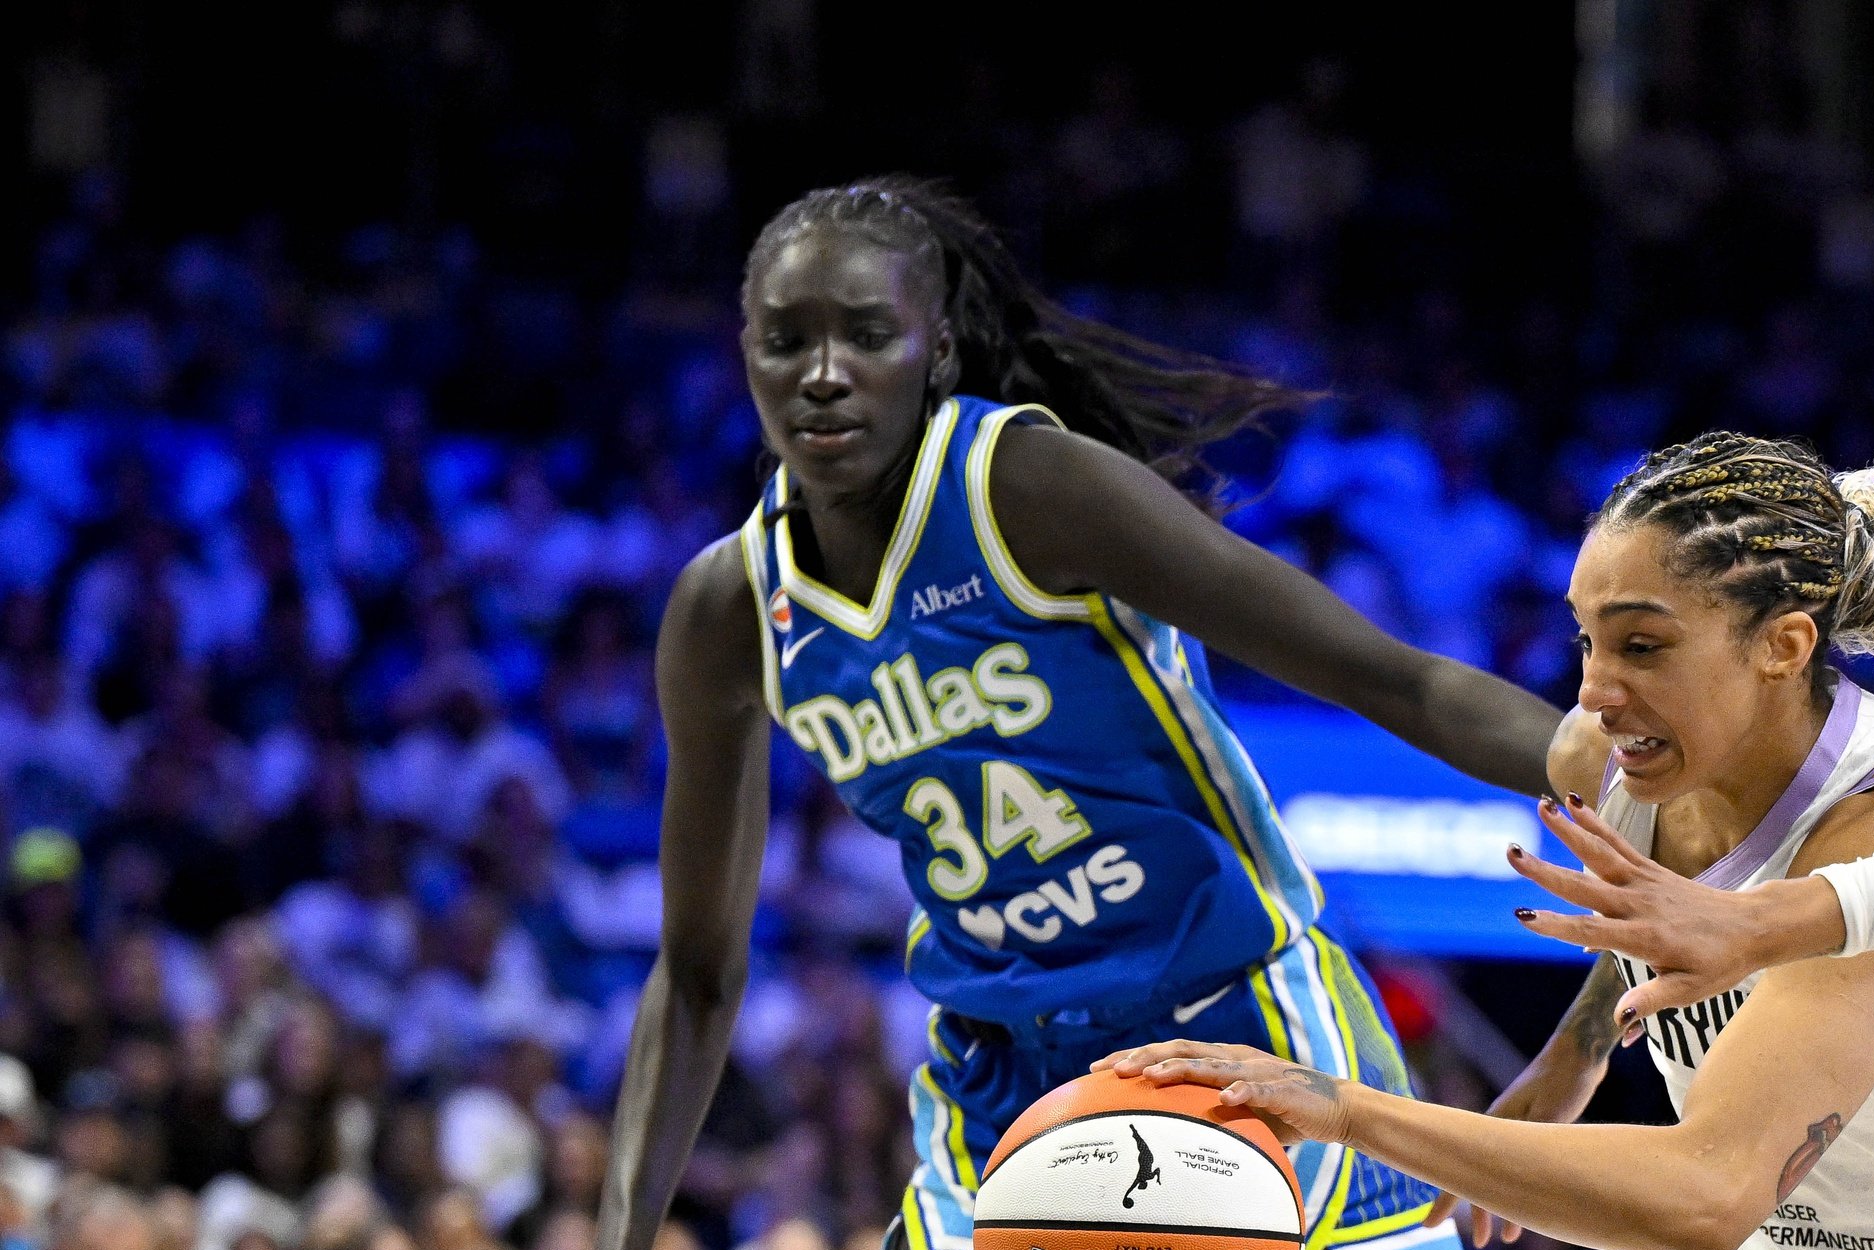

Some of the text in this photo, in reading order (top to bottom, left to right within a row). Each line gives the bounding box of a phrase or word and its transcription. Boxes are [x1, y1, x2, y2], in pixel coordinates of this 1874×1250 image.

[910, 573, 985, 619] Albert
[786, 643, 1052, 783] Dallas
[904, 760, 1093, 901] 34
[1004, 844, 1145, 943] CVS
[1174, 1150, 1205, 1162] BALL
[1182, 1161, 1233, 1177] OFFICIAL
[1207, 1156, 1240, 1170] GAME
[1774, 1203, 1820, 1223] ISER
